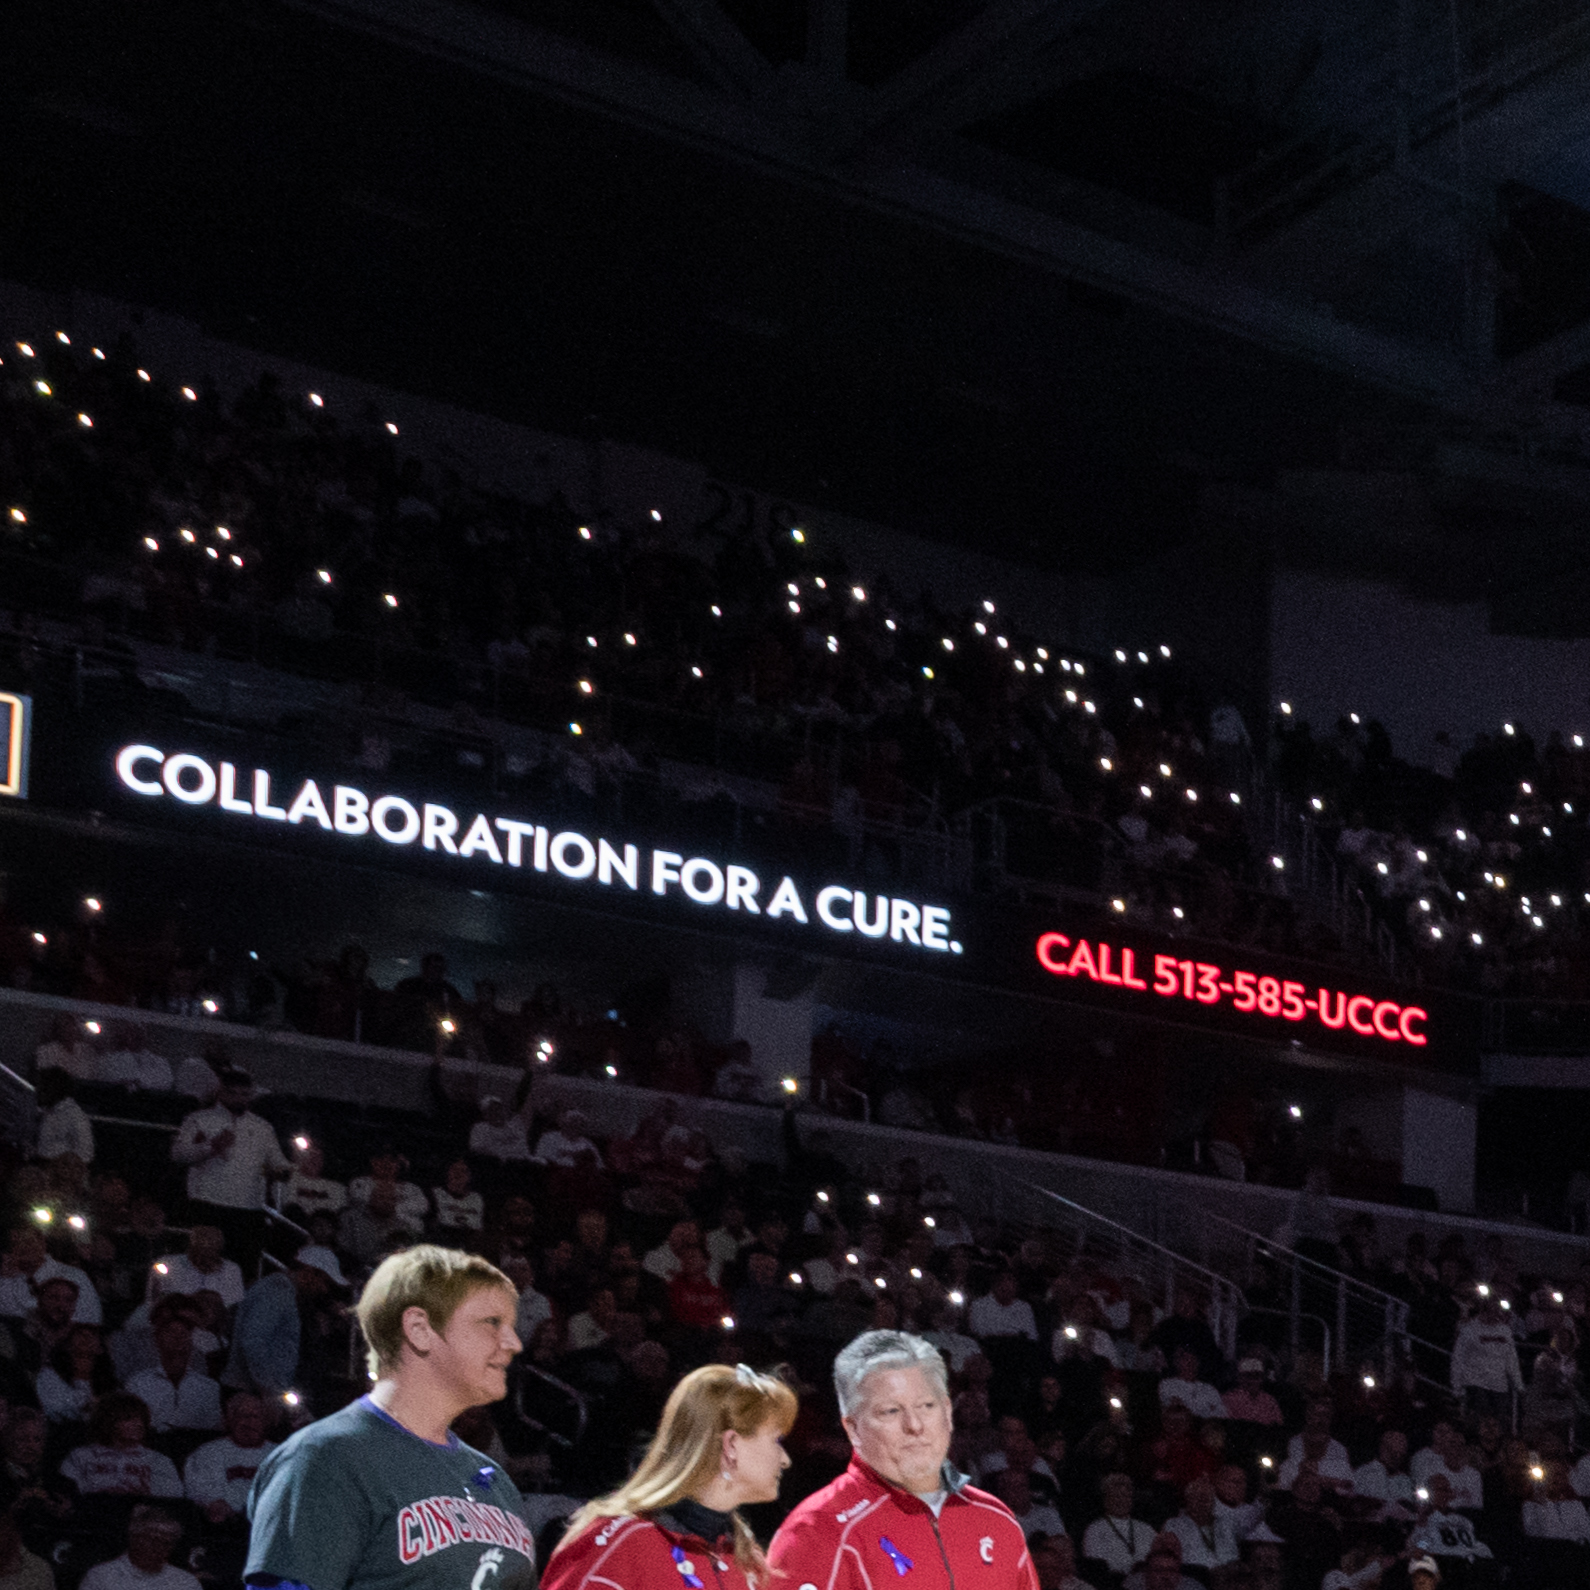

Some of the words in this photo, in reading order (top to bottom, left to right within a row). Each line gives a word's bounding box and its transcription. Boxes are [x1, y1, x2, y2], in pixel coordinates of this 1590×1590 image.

[116, 744, 638, 890] COLLABORATION
[652, 850, 760, 915] FOR
[766, 876, 809, 924] A
[816, 885, 964, 954] CURE.
[1036, 931, 1147, 991] CALL
[1153, 953, 1428, 1046] 513-585-UCCC
